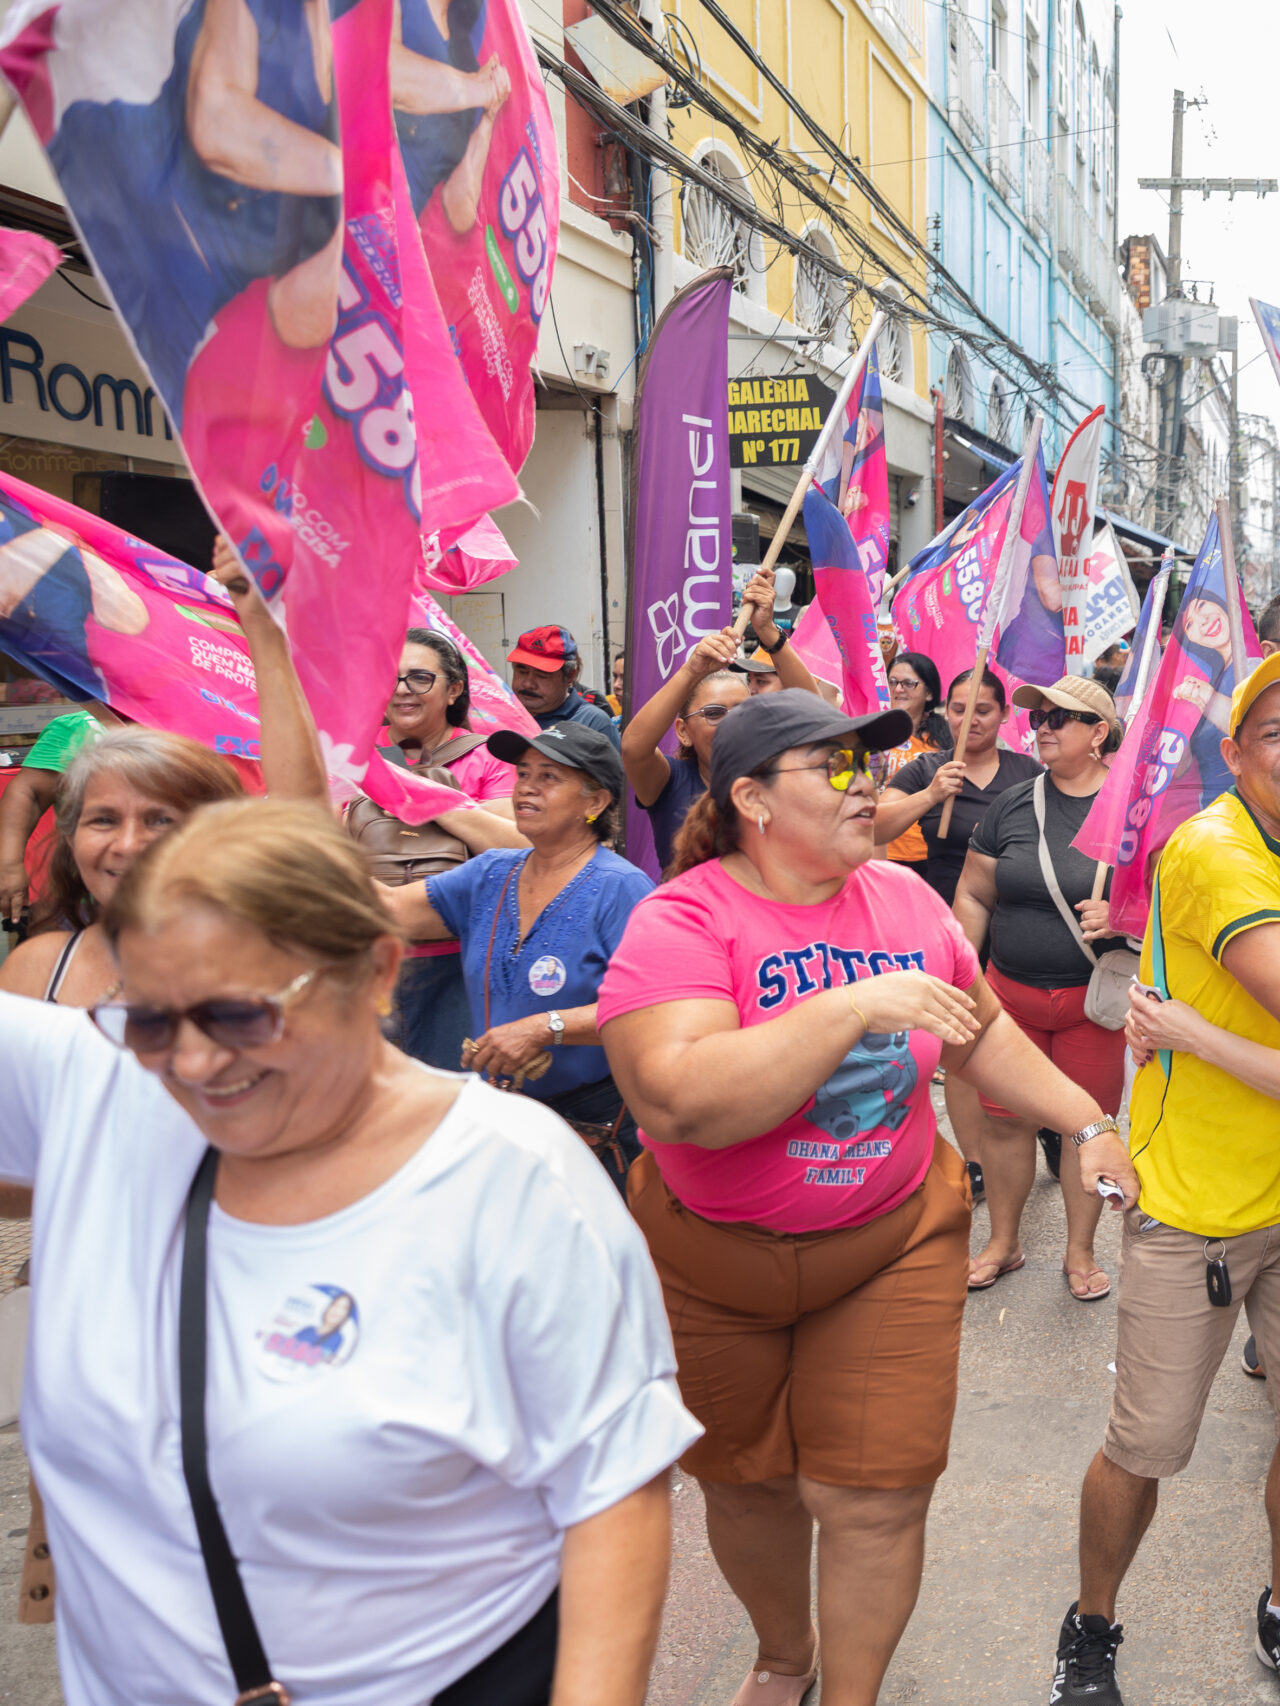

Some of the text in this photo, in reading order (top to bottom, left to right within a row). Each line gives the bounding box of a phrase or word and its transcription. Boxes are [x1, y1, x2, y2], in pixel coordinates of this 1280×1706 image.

[346, 216, 404, 310] FEDERAL
[574, 343, 610, 379] 175
[728, 378, 810, 406] GALERIA
[768, 437, 801, 463] 177
[189, 645, 234, 671] QUEM
[191, 655, 213, 673] DE
[786, 1138, 893, 1161] OHANA MEANS
[803, 1166, 867, 1185] FAMILY
